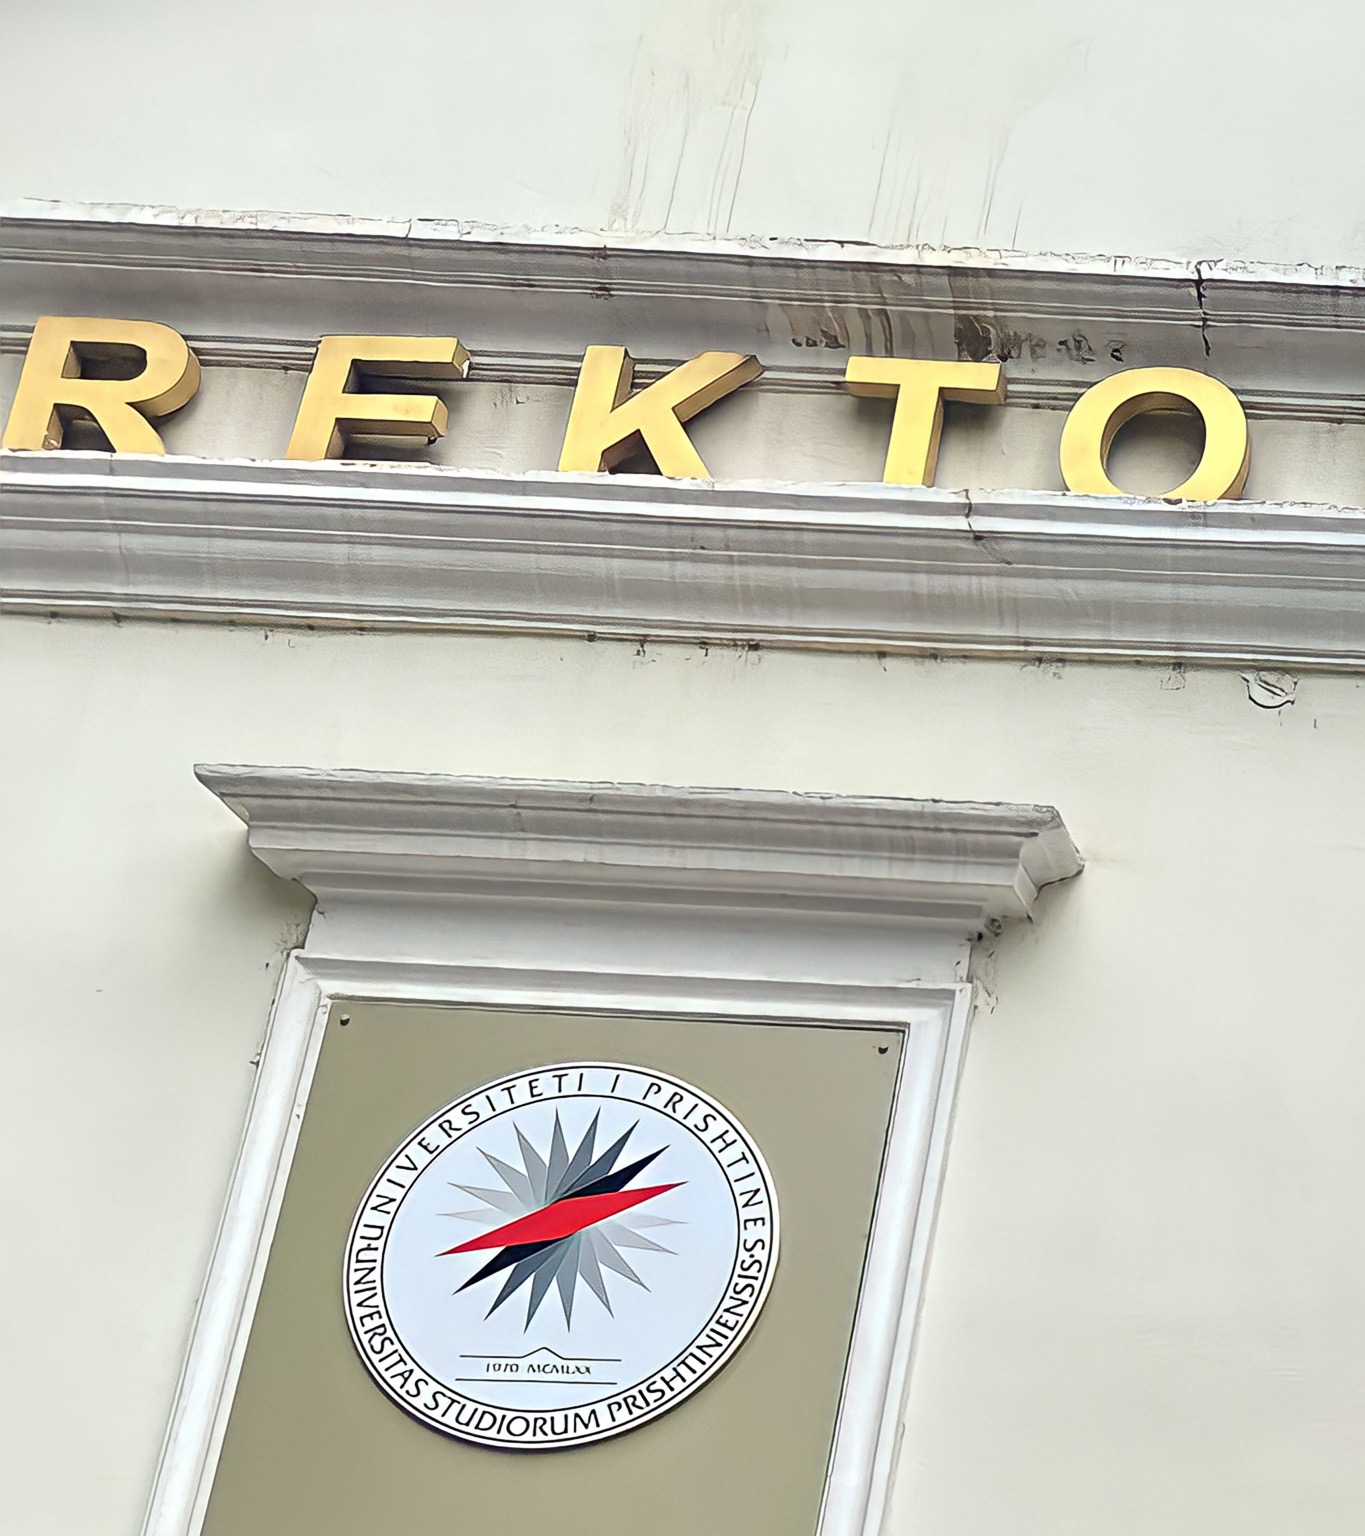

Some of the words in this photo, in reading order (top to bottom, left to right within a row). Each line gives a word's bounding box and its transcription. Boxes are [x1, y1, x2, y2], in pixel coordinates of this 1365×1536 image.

[360, 1072, 584, 1241] UNIVERSITETI
[611, 1074, 620, 1093] I
[642, 1082, 766, 1252] PRISHTINES
[353, 1247, 429, 1398] UNIVERSITAS
[423, 1391, 601, 1438] STUDIORUM
[607, 1259, 763, 1422] PRISHTINIENSIS
